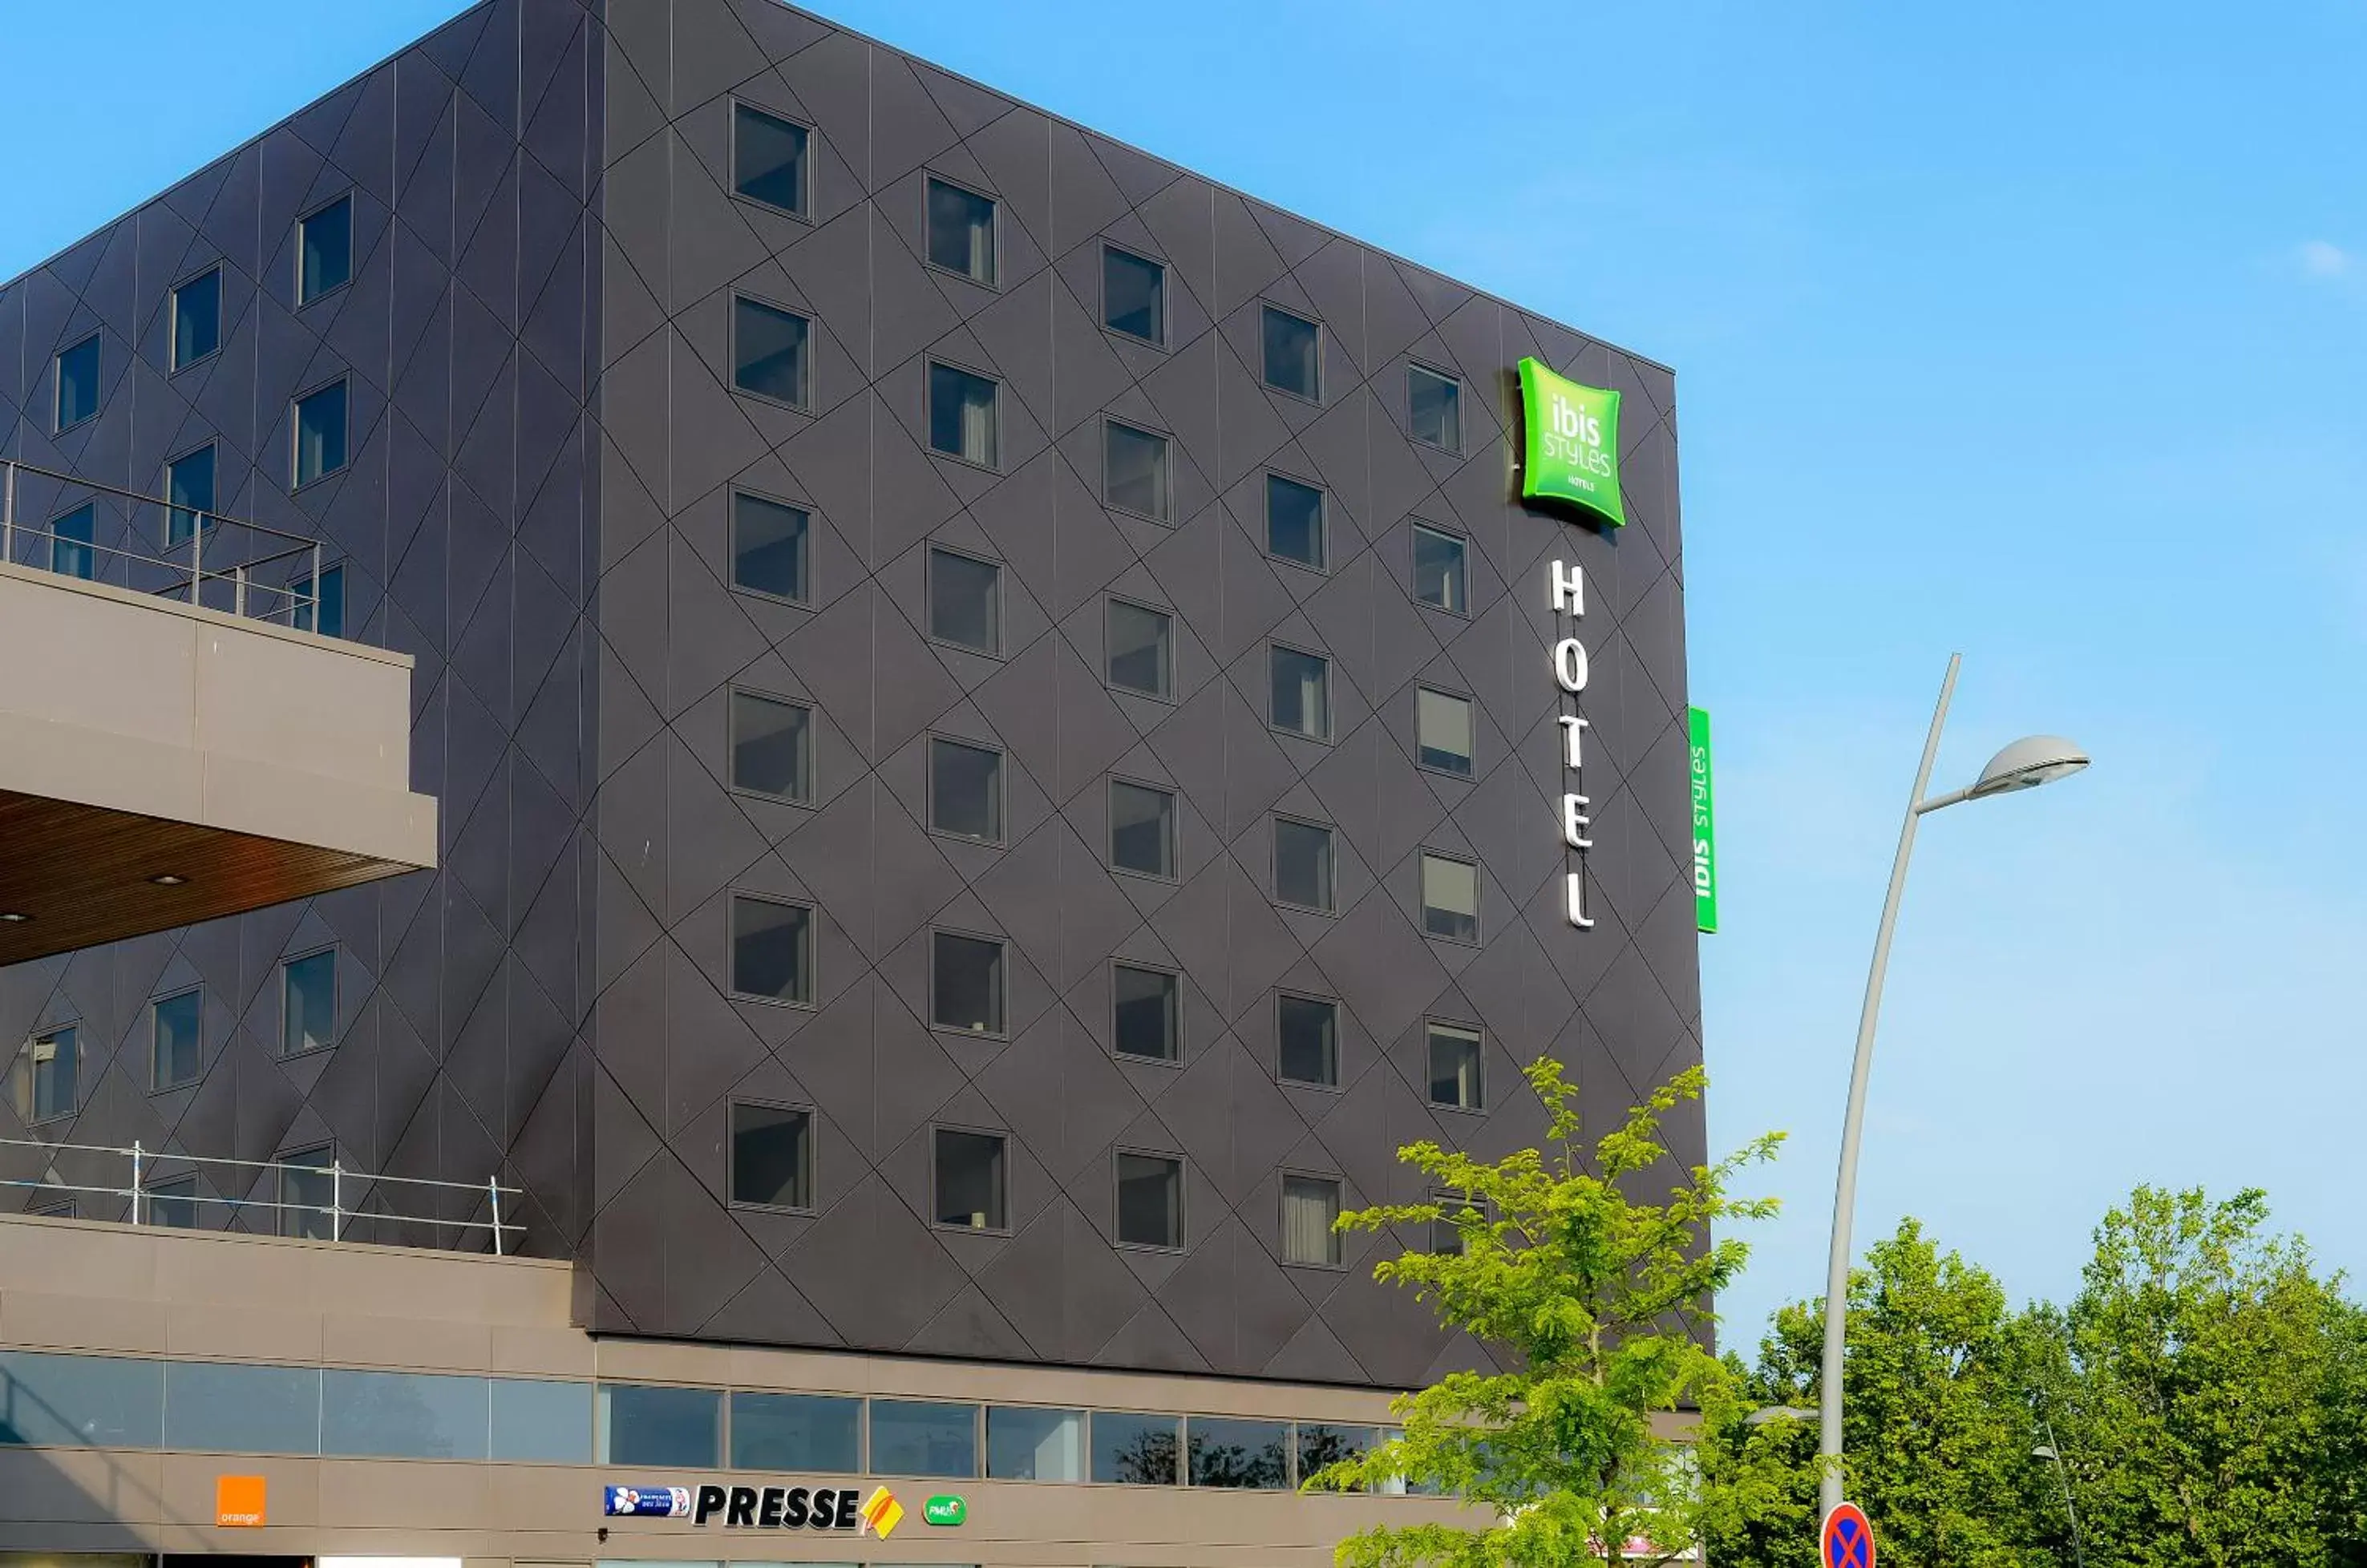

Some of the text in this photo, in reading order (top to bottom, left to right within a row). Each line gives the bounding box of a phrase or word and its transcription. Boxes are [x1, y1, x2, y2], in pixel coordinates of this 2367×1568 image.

[1552, 393, 1601, 447] ibis
[1568, 475, 1595, 491] HOTELS
[1551, 560, 1594, 927] HOTEL
[221, 1513, 260, 1524] orange
[692, 1485, 860, 1530] PRESSE
[929, 1505, 953, 1517] PMU
